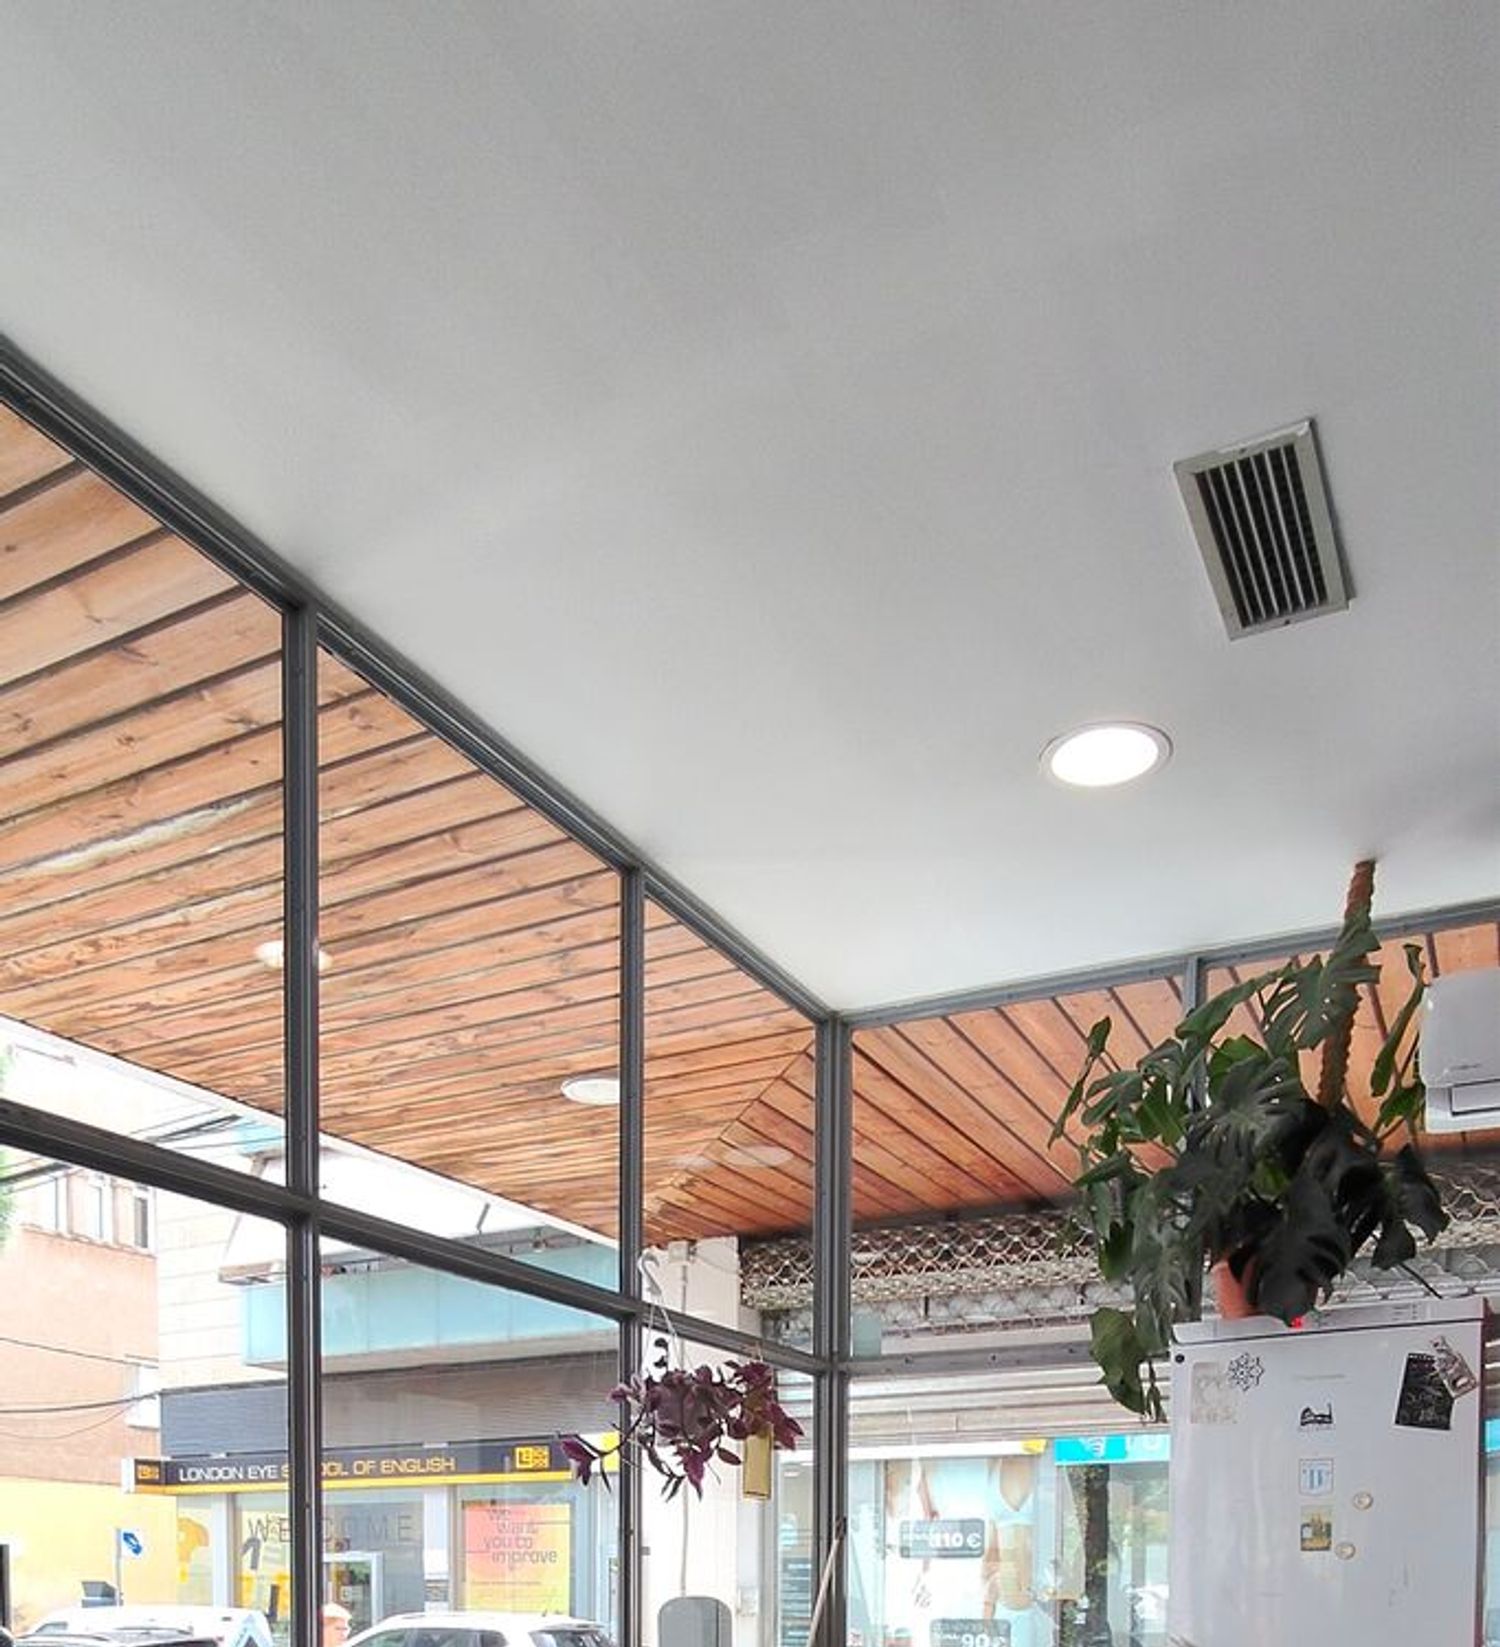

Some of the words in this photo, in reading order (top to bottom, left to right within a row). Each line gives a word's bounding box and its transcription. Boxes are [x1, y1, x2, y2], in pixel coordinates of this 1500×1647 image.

[179, 1466, 243, 1482] LONDON
[247, 1464, 278, 1480] EYE
[353, 1460, 376, 1475] OF
[381, 1457, 456, 1473] ENGLISH
[491, 1549, 558, 1571] improve
